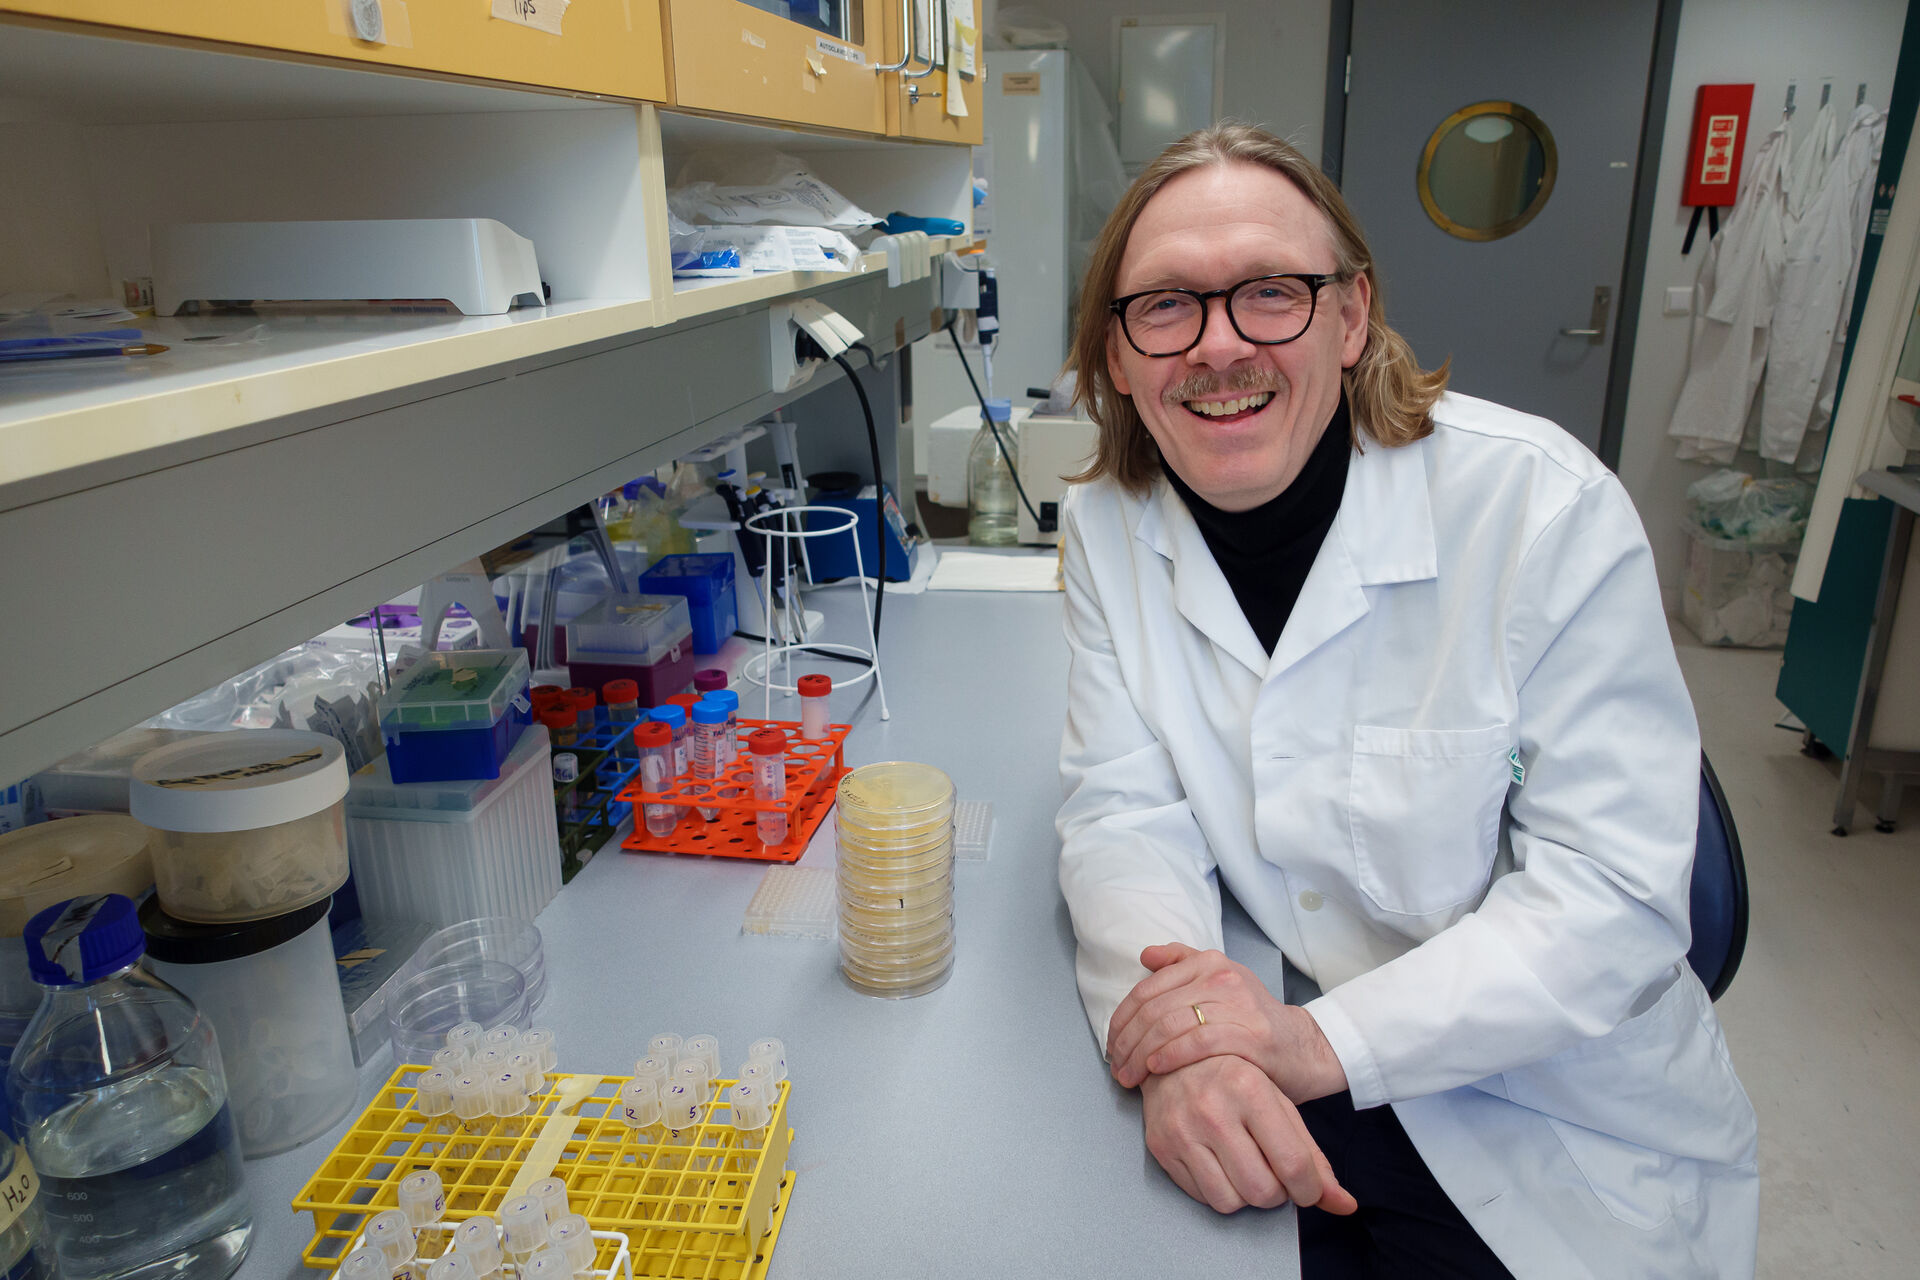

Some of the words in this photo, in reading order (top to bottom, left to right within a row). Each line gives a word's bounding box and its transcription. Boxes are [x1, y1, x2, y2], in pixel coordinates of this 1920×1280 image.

[689, 1105, 697, 1119] 5
[66, 1192, 88, 1201] 600
[72, 1213, 94, 1222] 500
